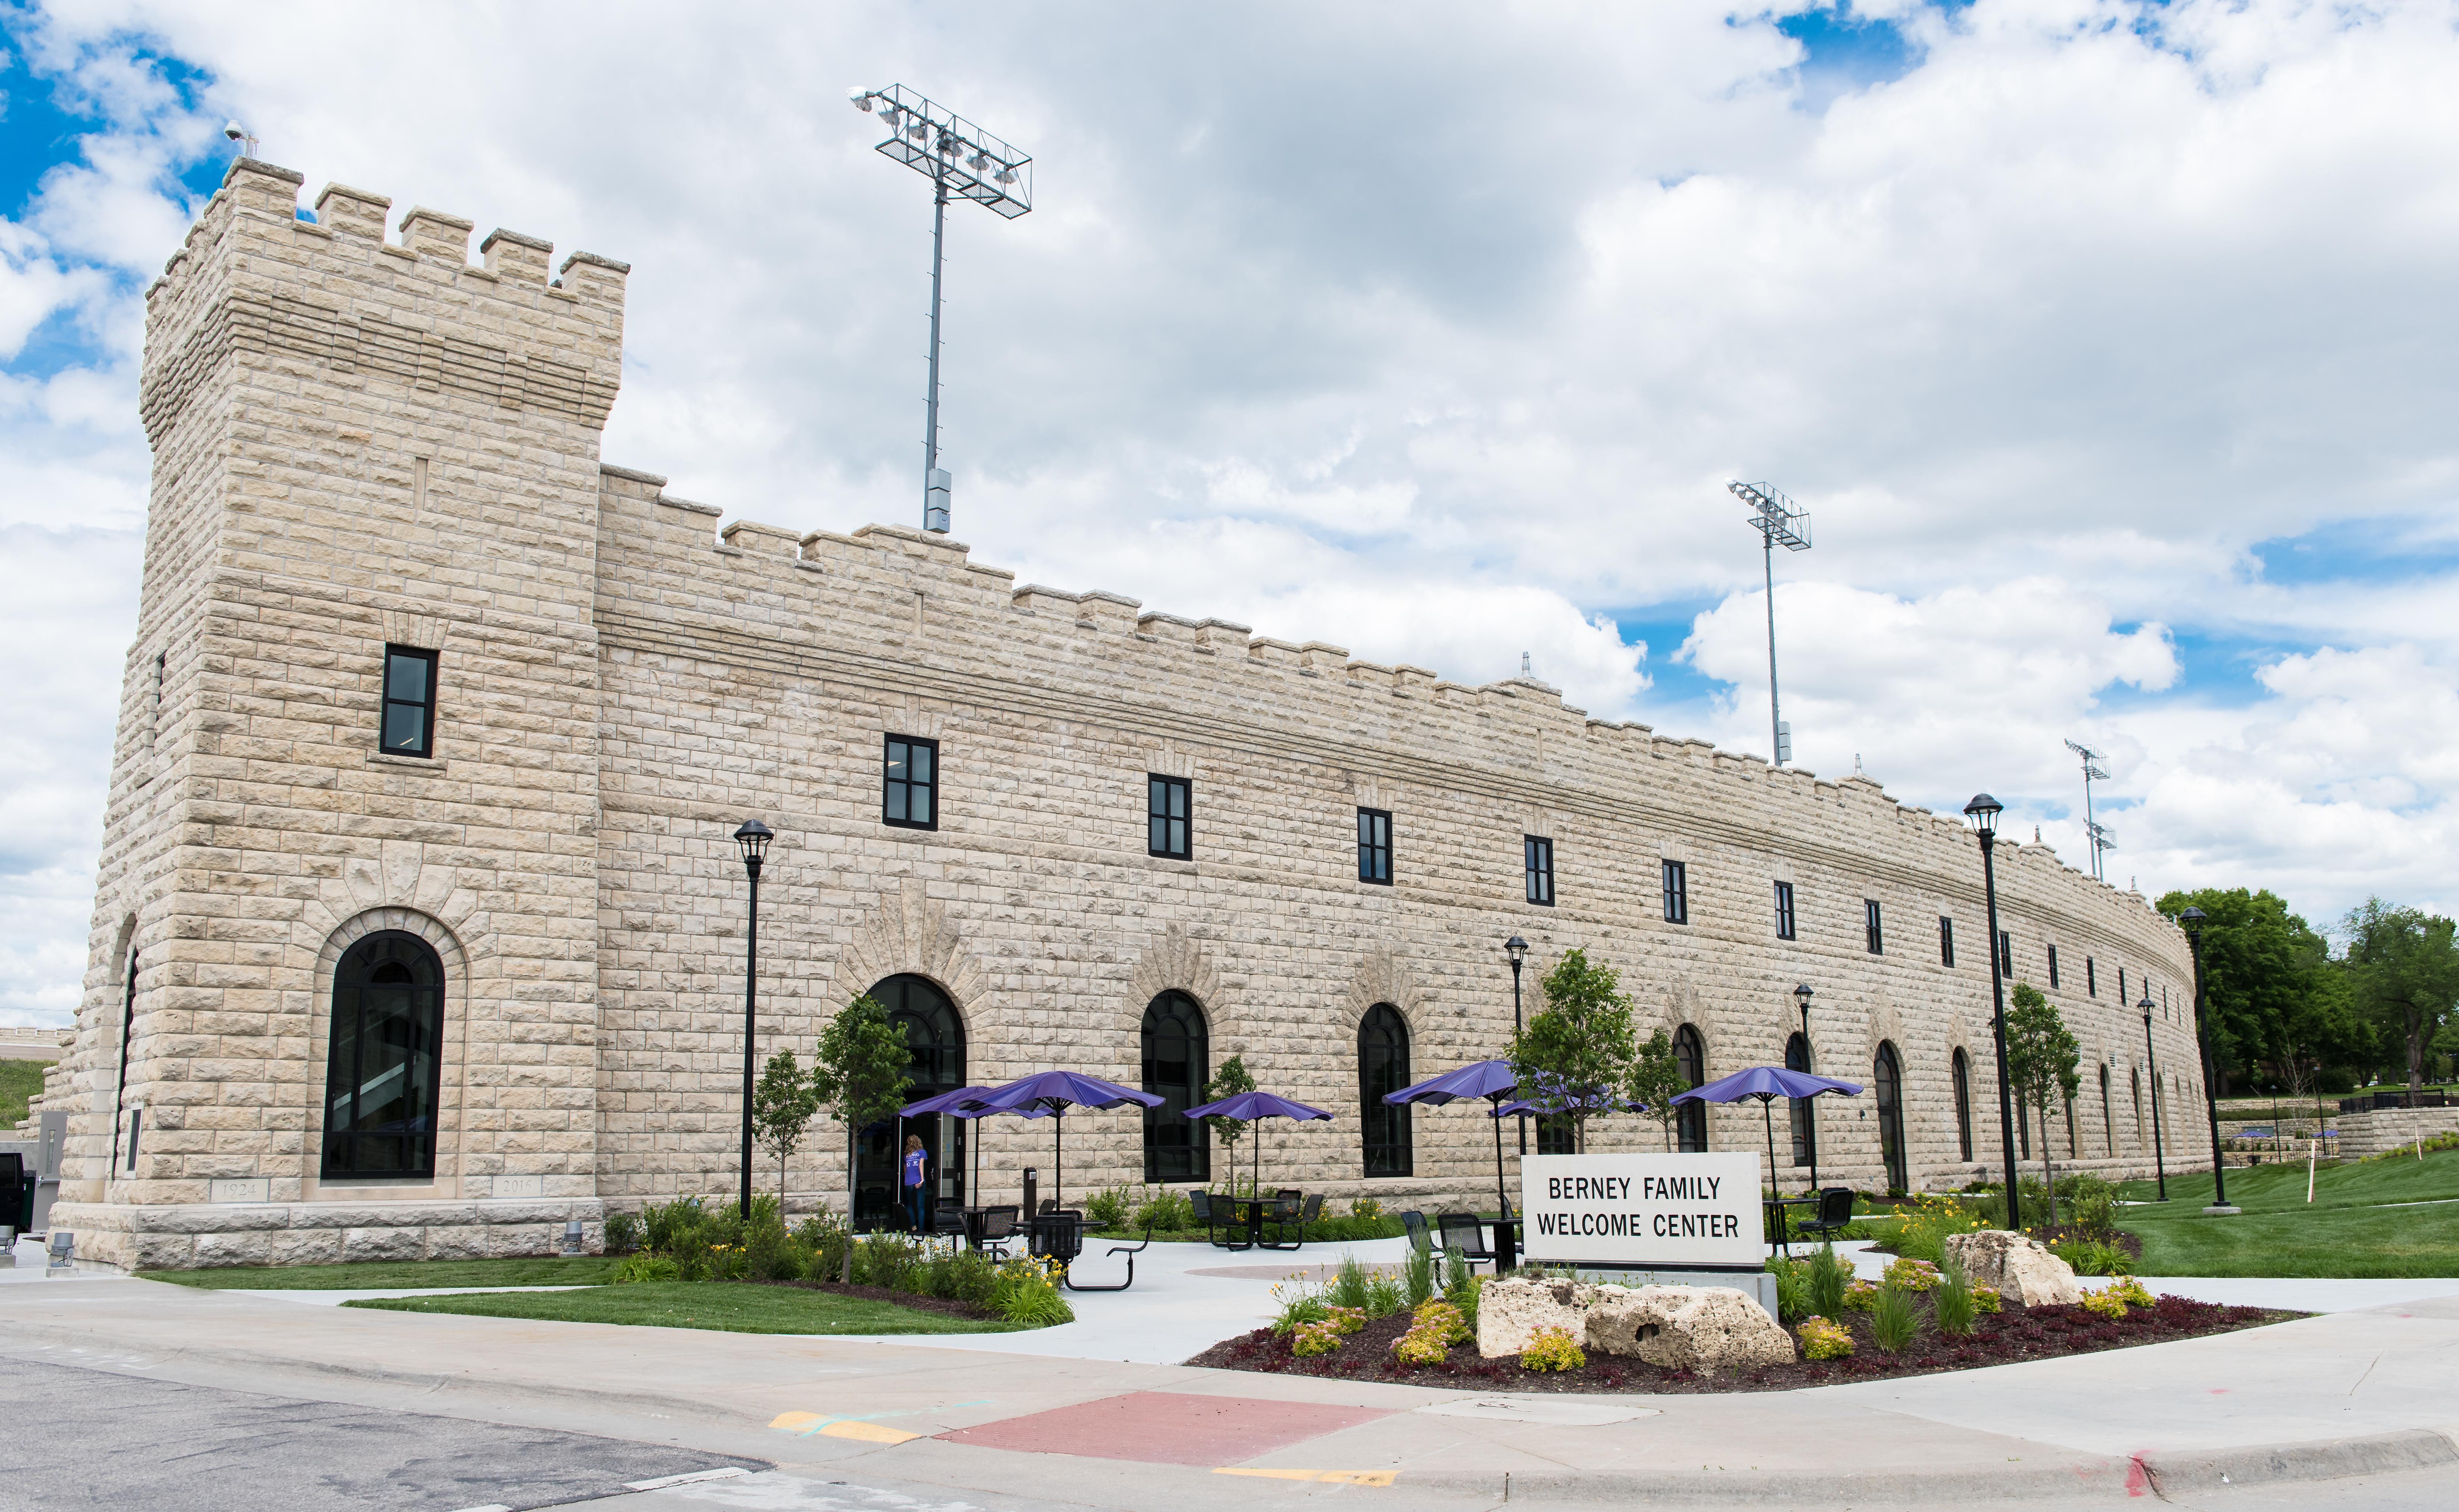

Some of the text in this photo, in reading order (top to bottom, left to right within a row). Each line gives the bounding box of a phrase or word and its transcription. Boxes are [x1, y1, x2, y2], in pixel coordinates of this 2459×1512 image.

[222, 1184, 257, 1196] 1924
[504, 1180, 532, 1192] 2016
[1549, 1177, 1720, 1199] BERNEY FAMILY
[1537, 1213, 1738, 1238] WELCOME CENTER
